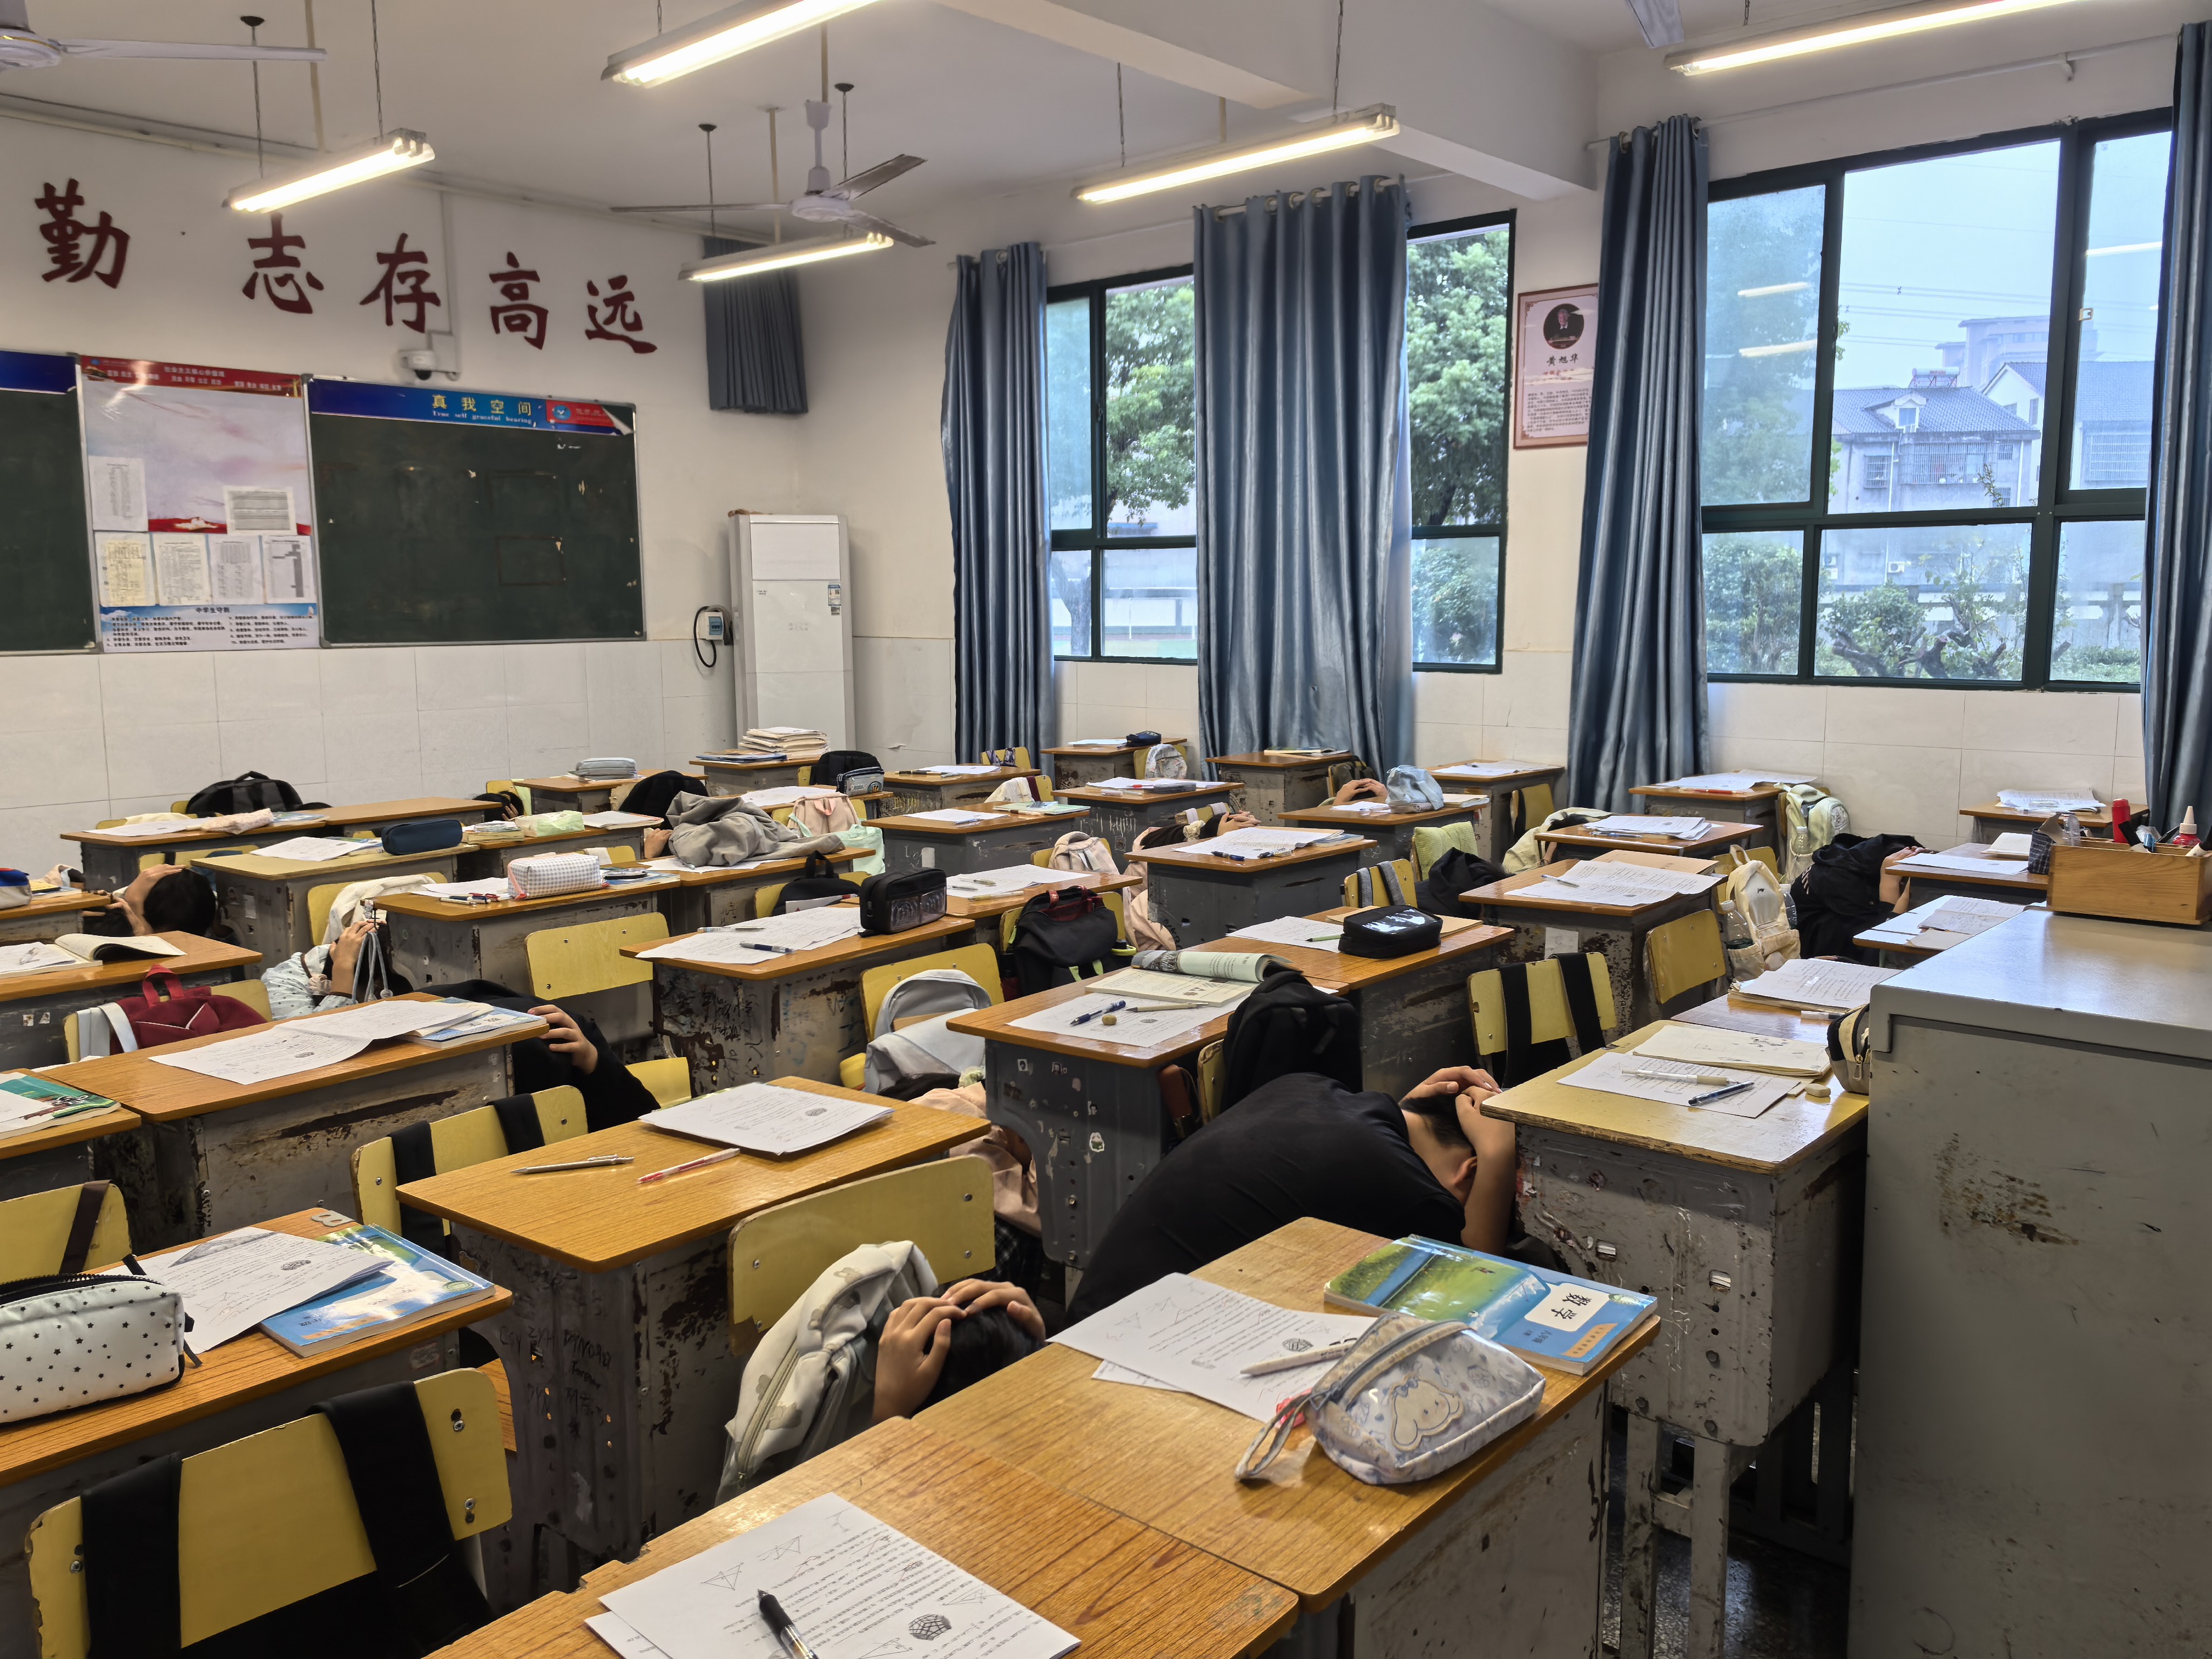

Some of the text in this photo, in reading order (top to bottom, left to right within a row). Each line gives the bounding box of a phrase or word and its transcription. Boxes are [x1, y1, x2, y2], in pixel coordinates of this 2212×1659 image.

[35, 178, 130, 289] 勤
[242, 214, 657, 354] 志存高远
[432, 394, 532, 416] 真我空间
[1550, 1292, 1593, 1319] 数学
